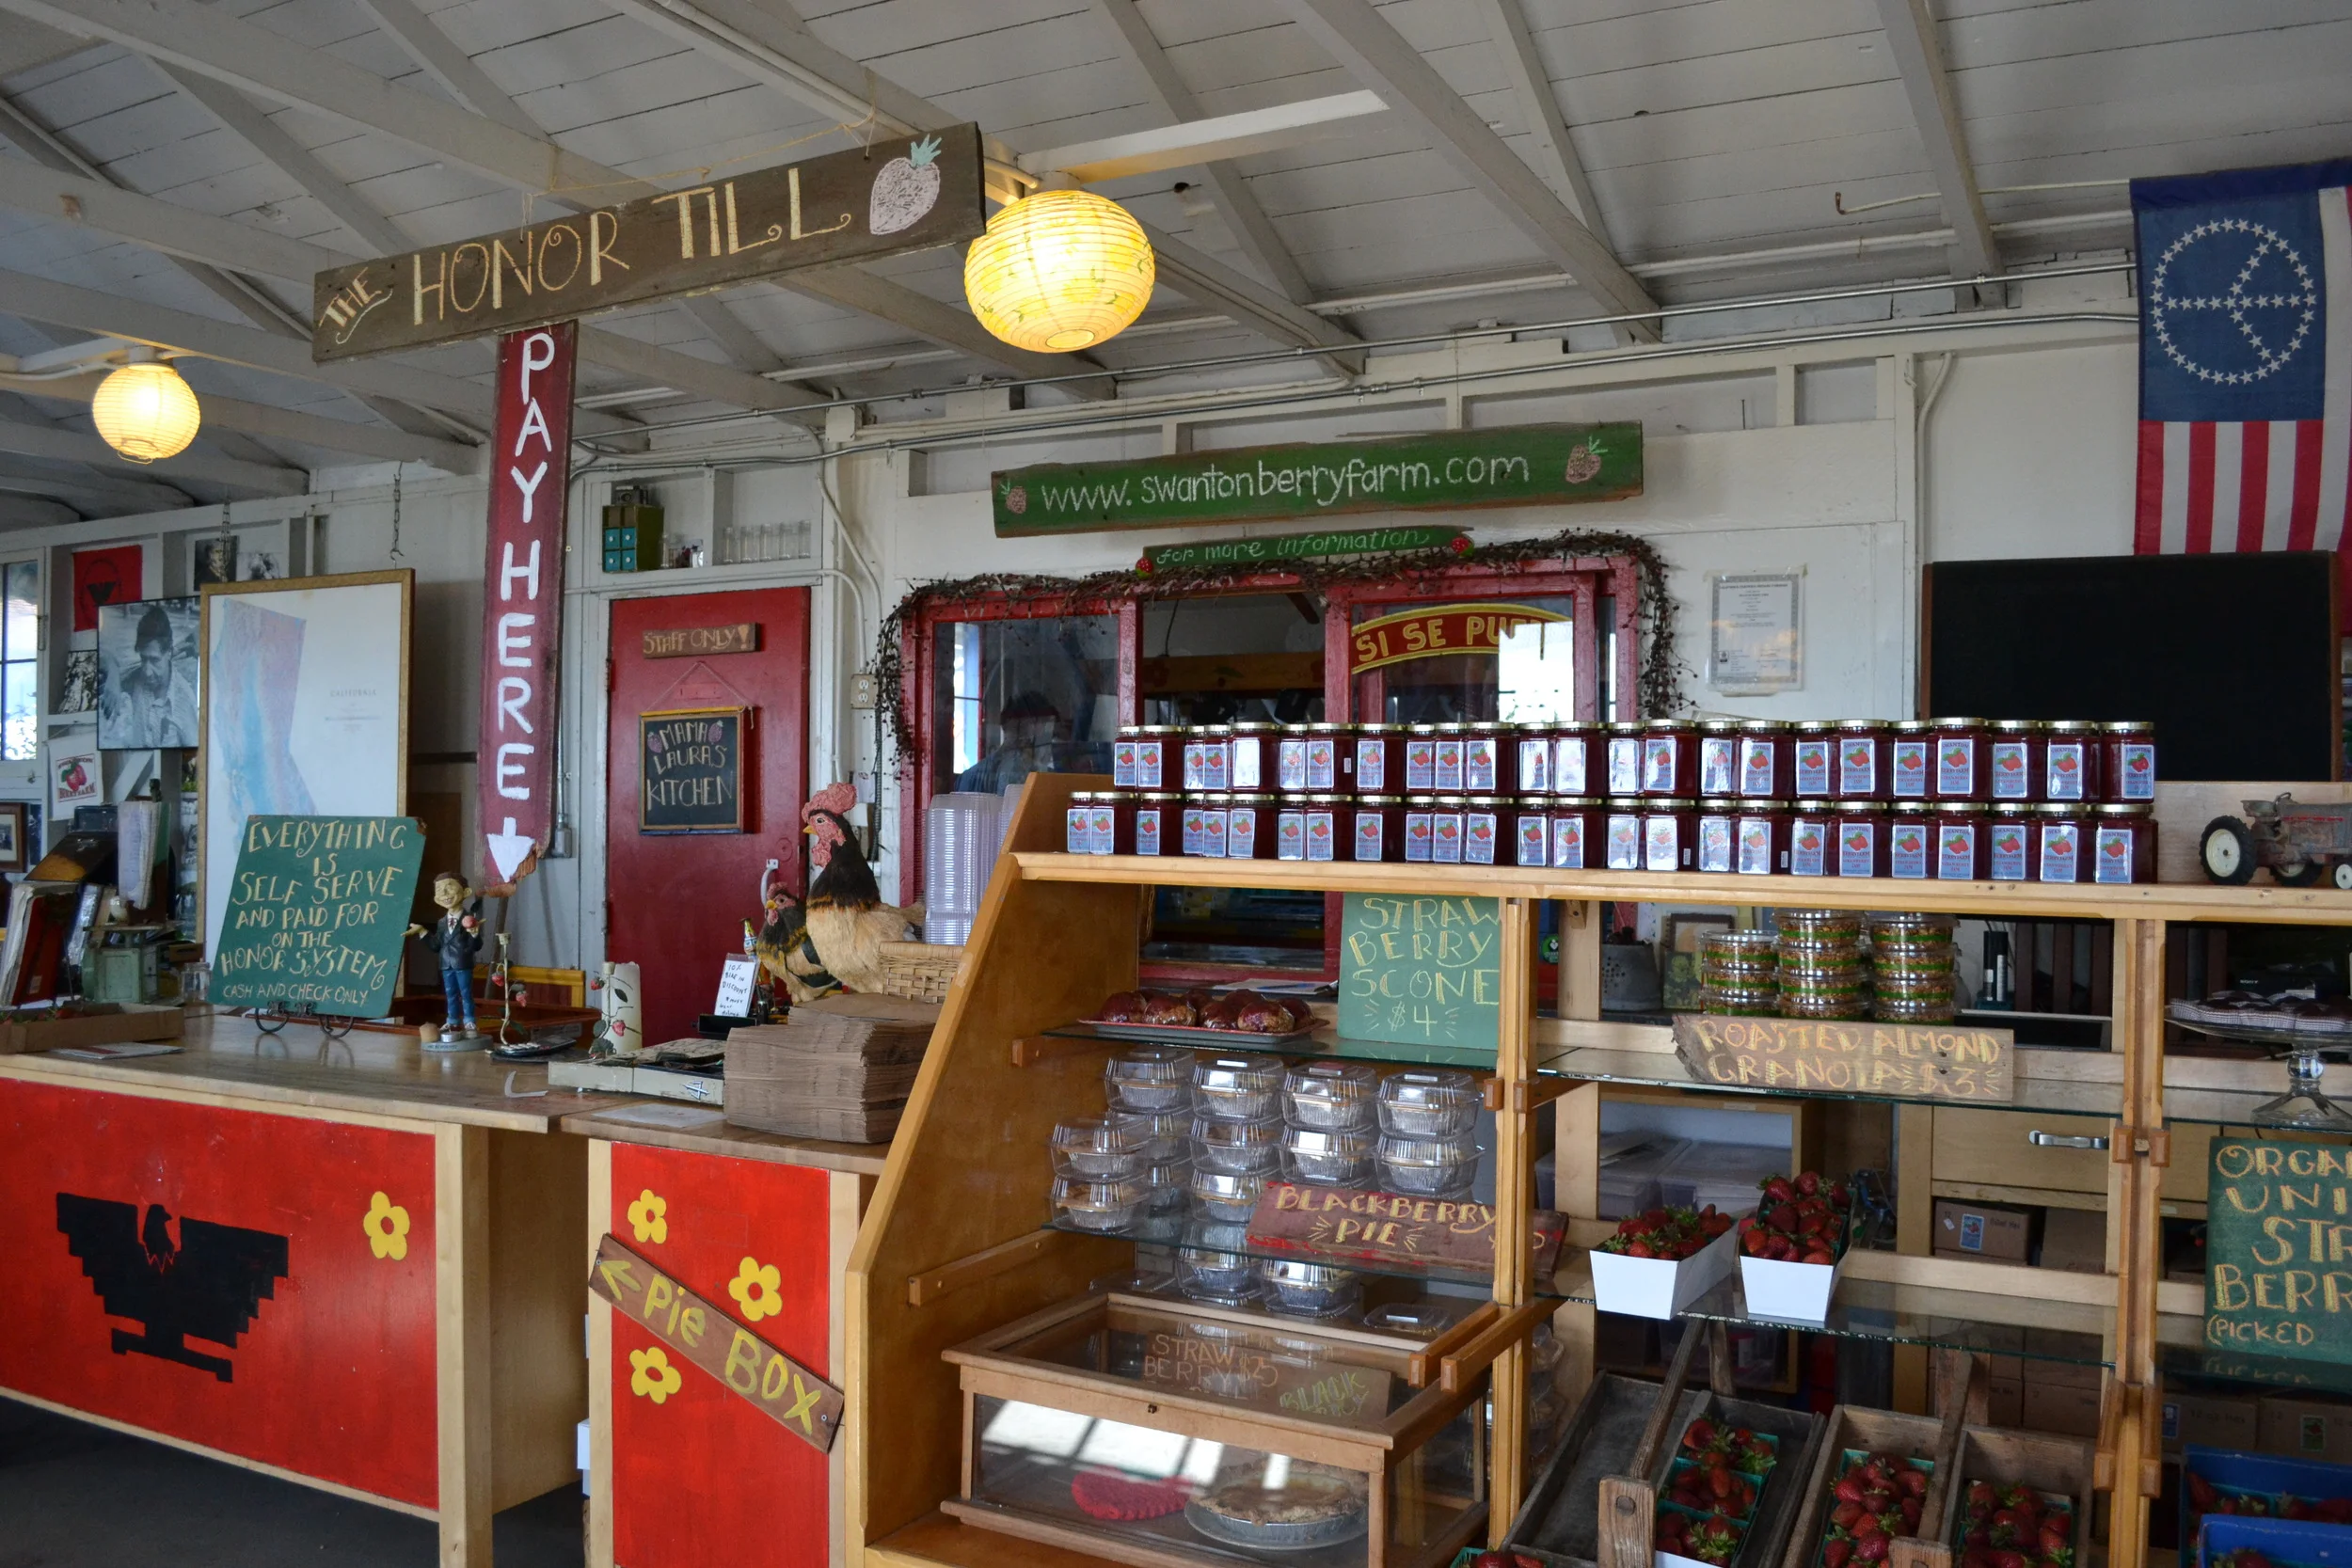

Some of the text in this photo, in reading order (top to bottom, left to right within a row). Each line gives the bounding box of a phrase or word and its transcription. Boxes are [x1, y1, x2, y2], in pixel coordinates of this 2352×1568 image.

[319, 167, 851, 328] THE HONOR TILL
[510, 332, 555, 524] PAY
[1204, 541, 1266, 561] more
[1276, 529, 1432, 557] information
[644, 624, 750, 657] STAFF ONLY!
[1356, 631, 1390, 662] SI
[1403, 618, 1447, 651] SE
[497, 539, 542, 801] HERE
[660, 721, 708, 752] MAMA
[654, 745, 728, 776] LAURAS
[646, 769, 736, 812] KITCHEN
[247, 819, 407, 858] EVERYTHING
[312, 853, 338, 878] IS
[232, 866, 403, 906] SELF SERVE
[235, 901, 378, 930] AND PAID FOR
[1359, 897, 1499, 932] STRAW
[272, 930, 335, 949] ON THE
[1349, 930, 1493, 968] BERRY
[220, 943, 388, 990] HONOR SYSTEM
[223, 983, 369, 1007] CASH AND CHECK ONLY
[1351, 969, 1500, 1005] SCONE
[1388, 1001, 1438, 1037] $4
[1695, 1019, 2000, 1065] ROASTED ALMOND
[1708, 1053, 1902, 1091] GRANOLA
[1276, 1186, 1497, 1234] BLACKBERRY
[1335, 1218, 1402, 1246] PIE
[1152, 1334, 1235, 1366] STRAW
[1144, 1355, 1232, 1393] BERRY
